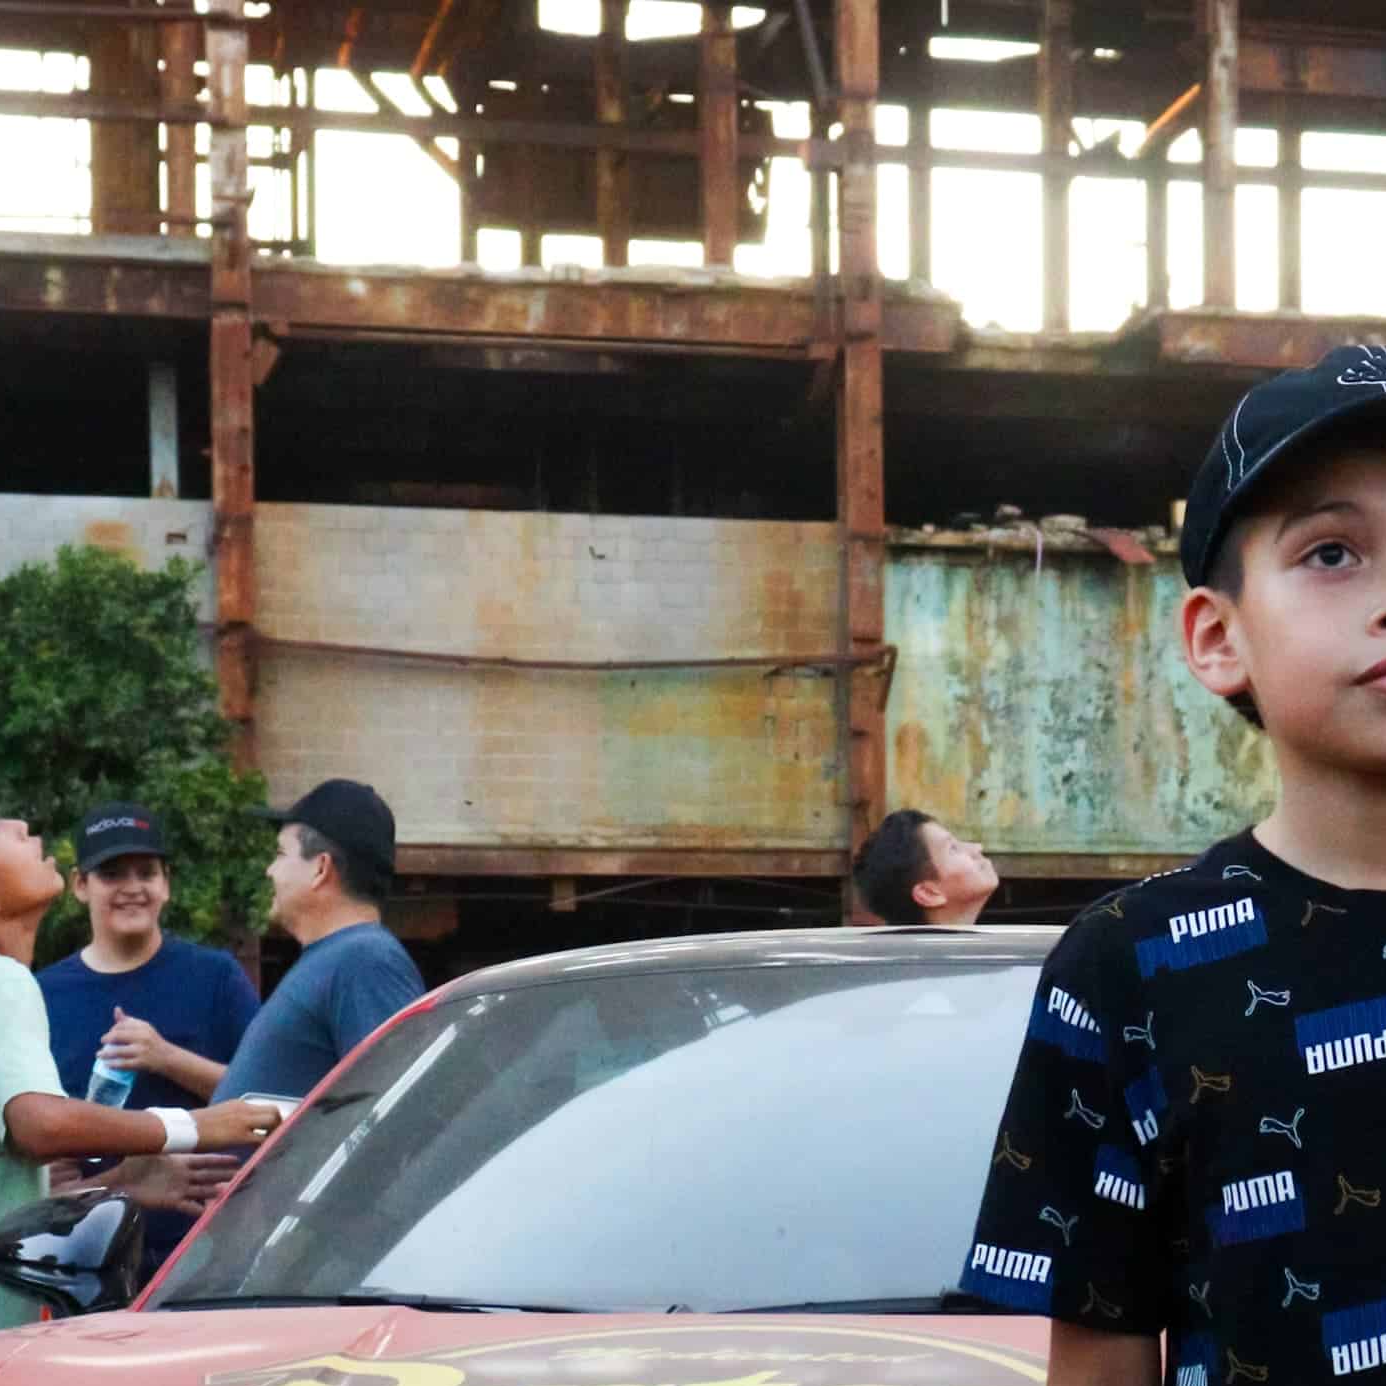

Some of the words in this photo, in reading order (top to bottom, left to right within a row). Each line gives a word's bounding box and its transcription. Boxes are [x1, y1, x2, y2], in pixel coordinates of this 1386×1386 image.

[1168, 897, 1255, 944] PUMA
[1222, 1170, 1296, 1215] PUMA
[971, 1243, 1052, 1283] PUMA
